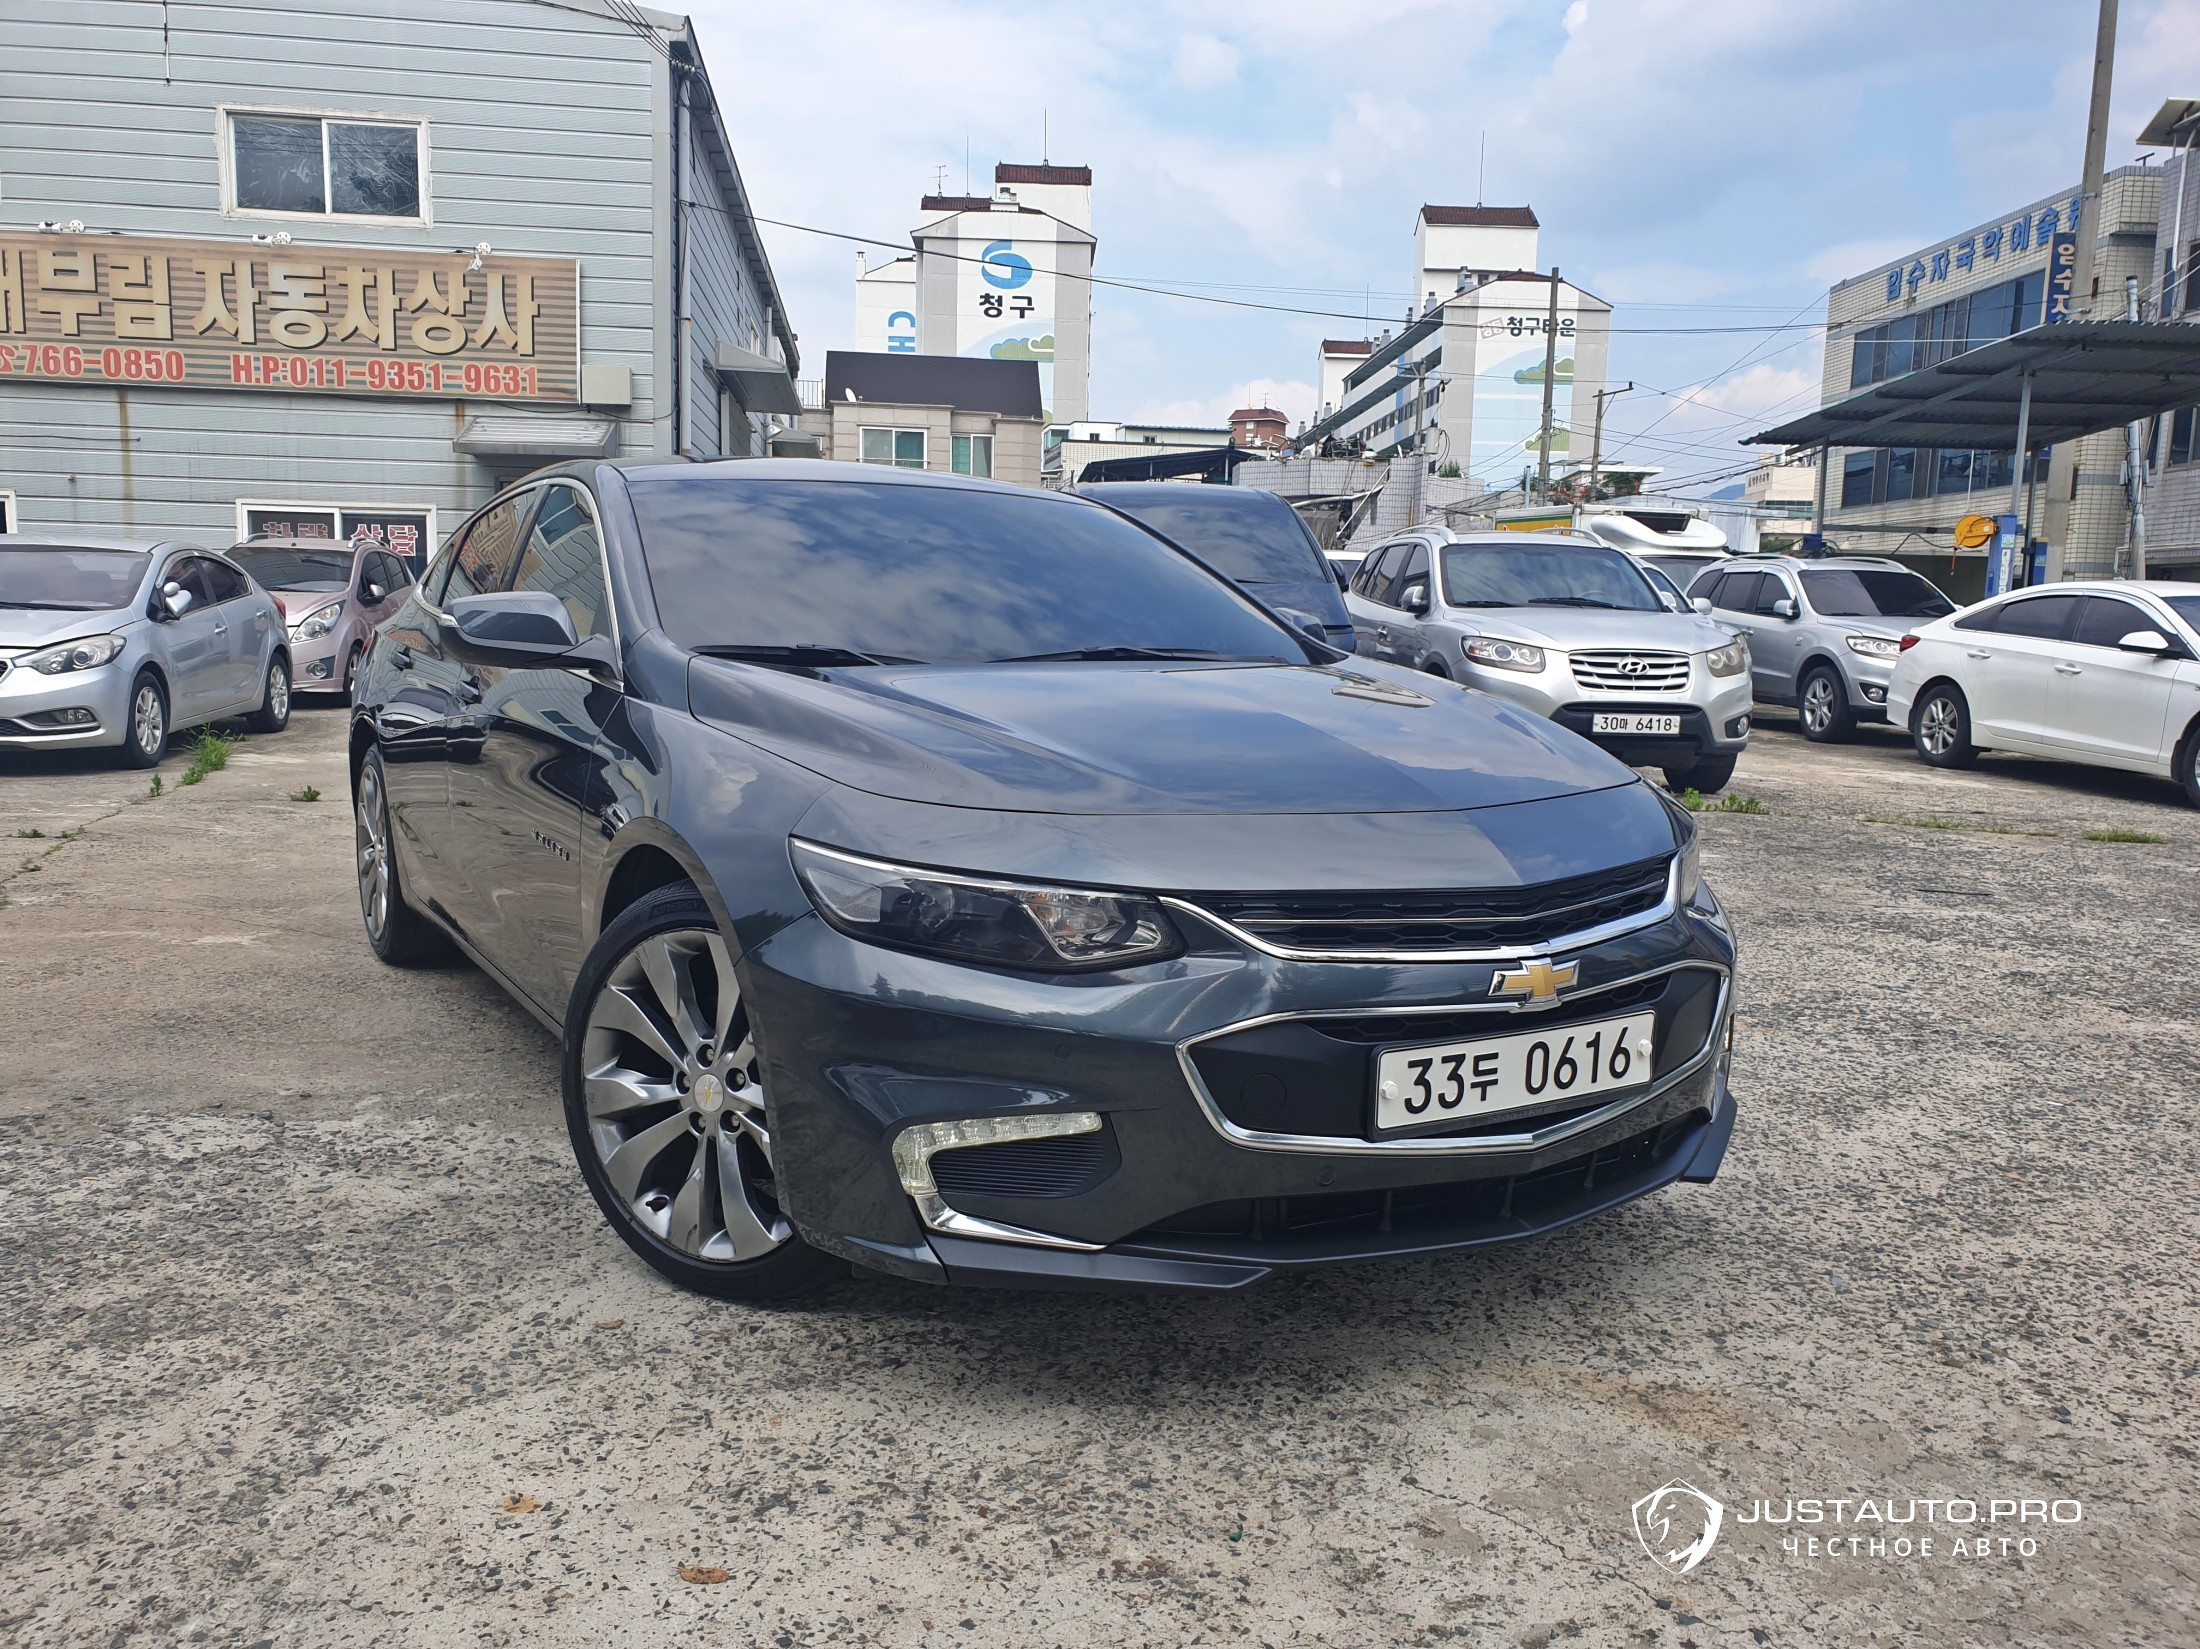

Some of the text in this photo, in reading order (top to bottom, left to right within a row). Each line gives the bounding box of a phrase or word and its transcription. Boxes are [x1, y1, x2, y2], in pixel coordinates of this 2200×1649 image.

[979, 293, 1035, 319] 청구
[20, 344, 184, 381] 766-0850
[1635, 717, 1672, 731] 6418
[1403, 1026, 1631, 1114] 33두 0616
